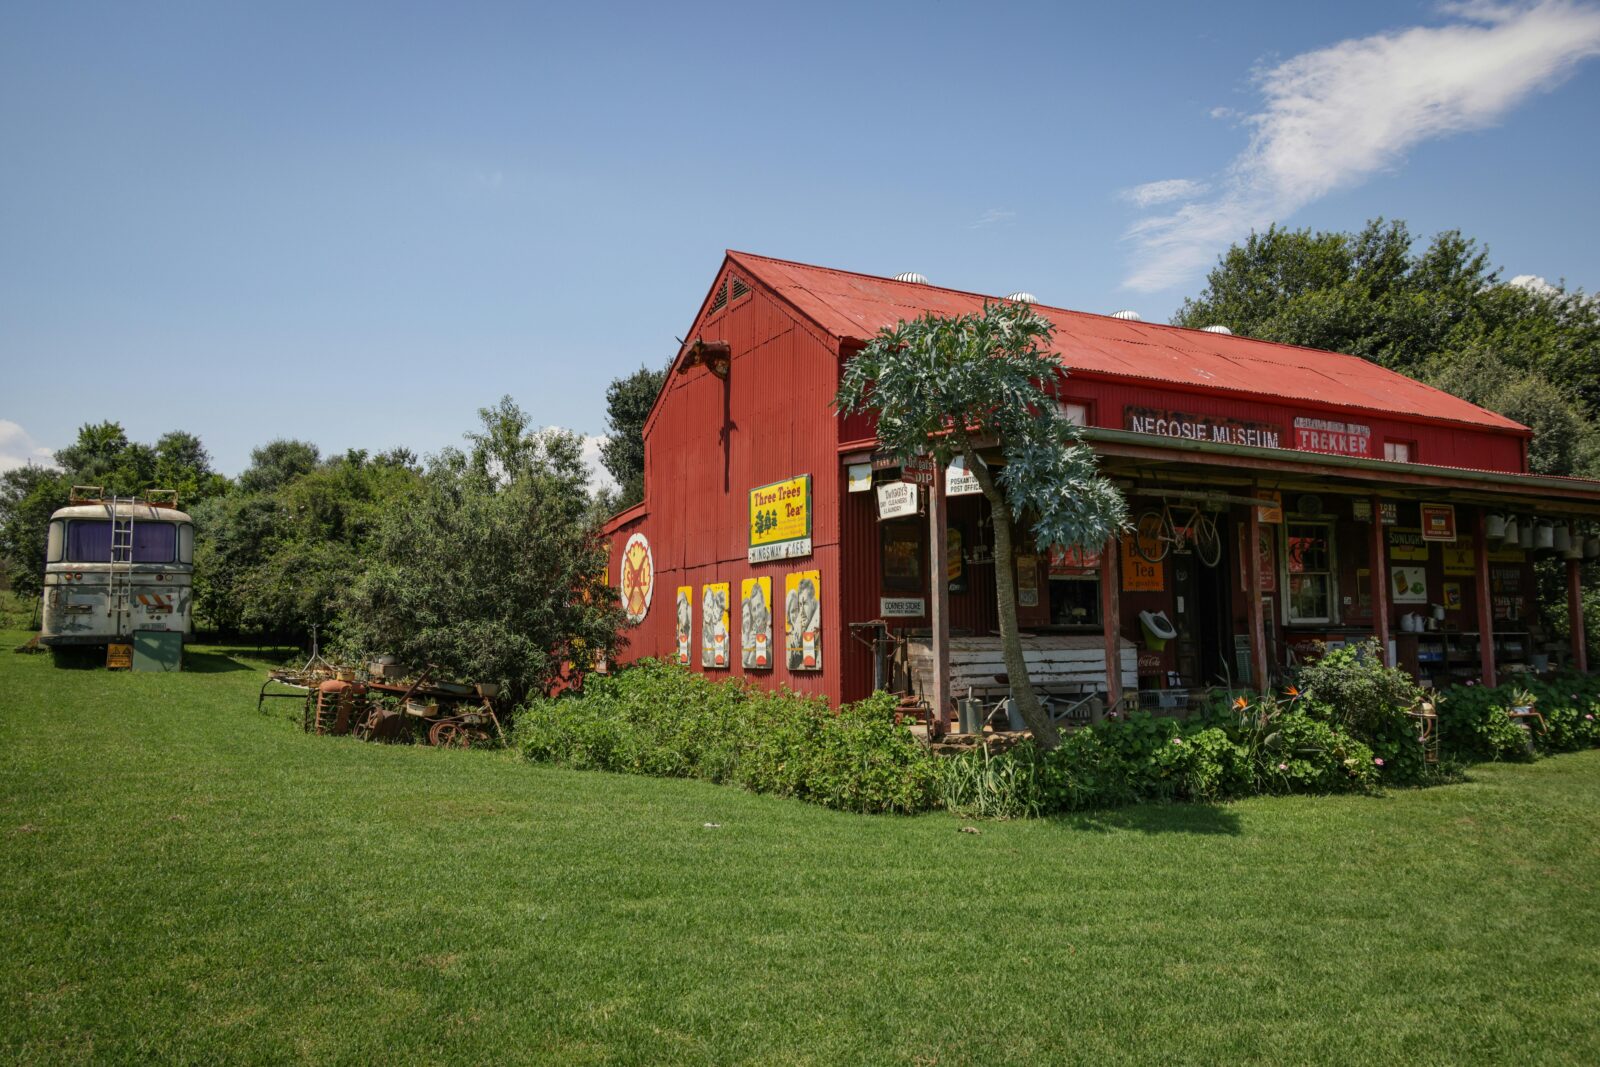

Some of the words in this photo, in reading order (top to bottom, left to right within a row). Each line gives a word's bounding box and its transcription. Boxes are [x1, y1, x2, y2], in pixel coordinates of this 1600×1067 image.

[1132, 415, 1207, 440] NEGOSIE
[1213, 425, 1279, 448] MUSEUM
[1299, 430, 1367, 453] TREKKER
[915, 472, 933, 483] DIP
[754, 491, 776, 507] Three
[778, 486, 801, 501] Trees
[950, 485, 963, 493] POST
[785, 503, 801, 517] Tea
[1132, 561, 1155, 577] Tea
[885, 602, 904, 610] CORNER
[905, 602, 921, 610] STORE
